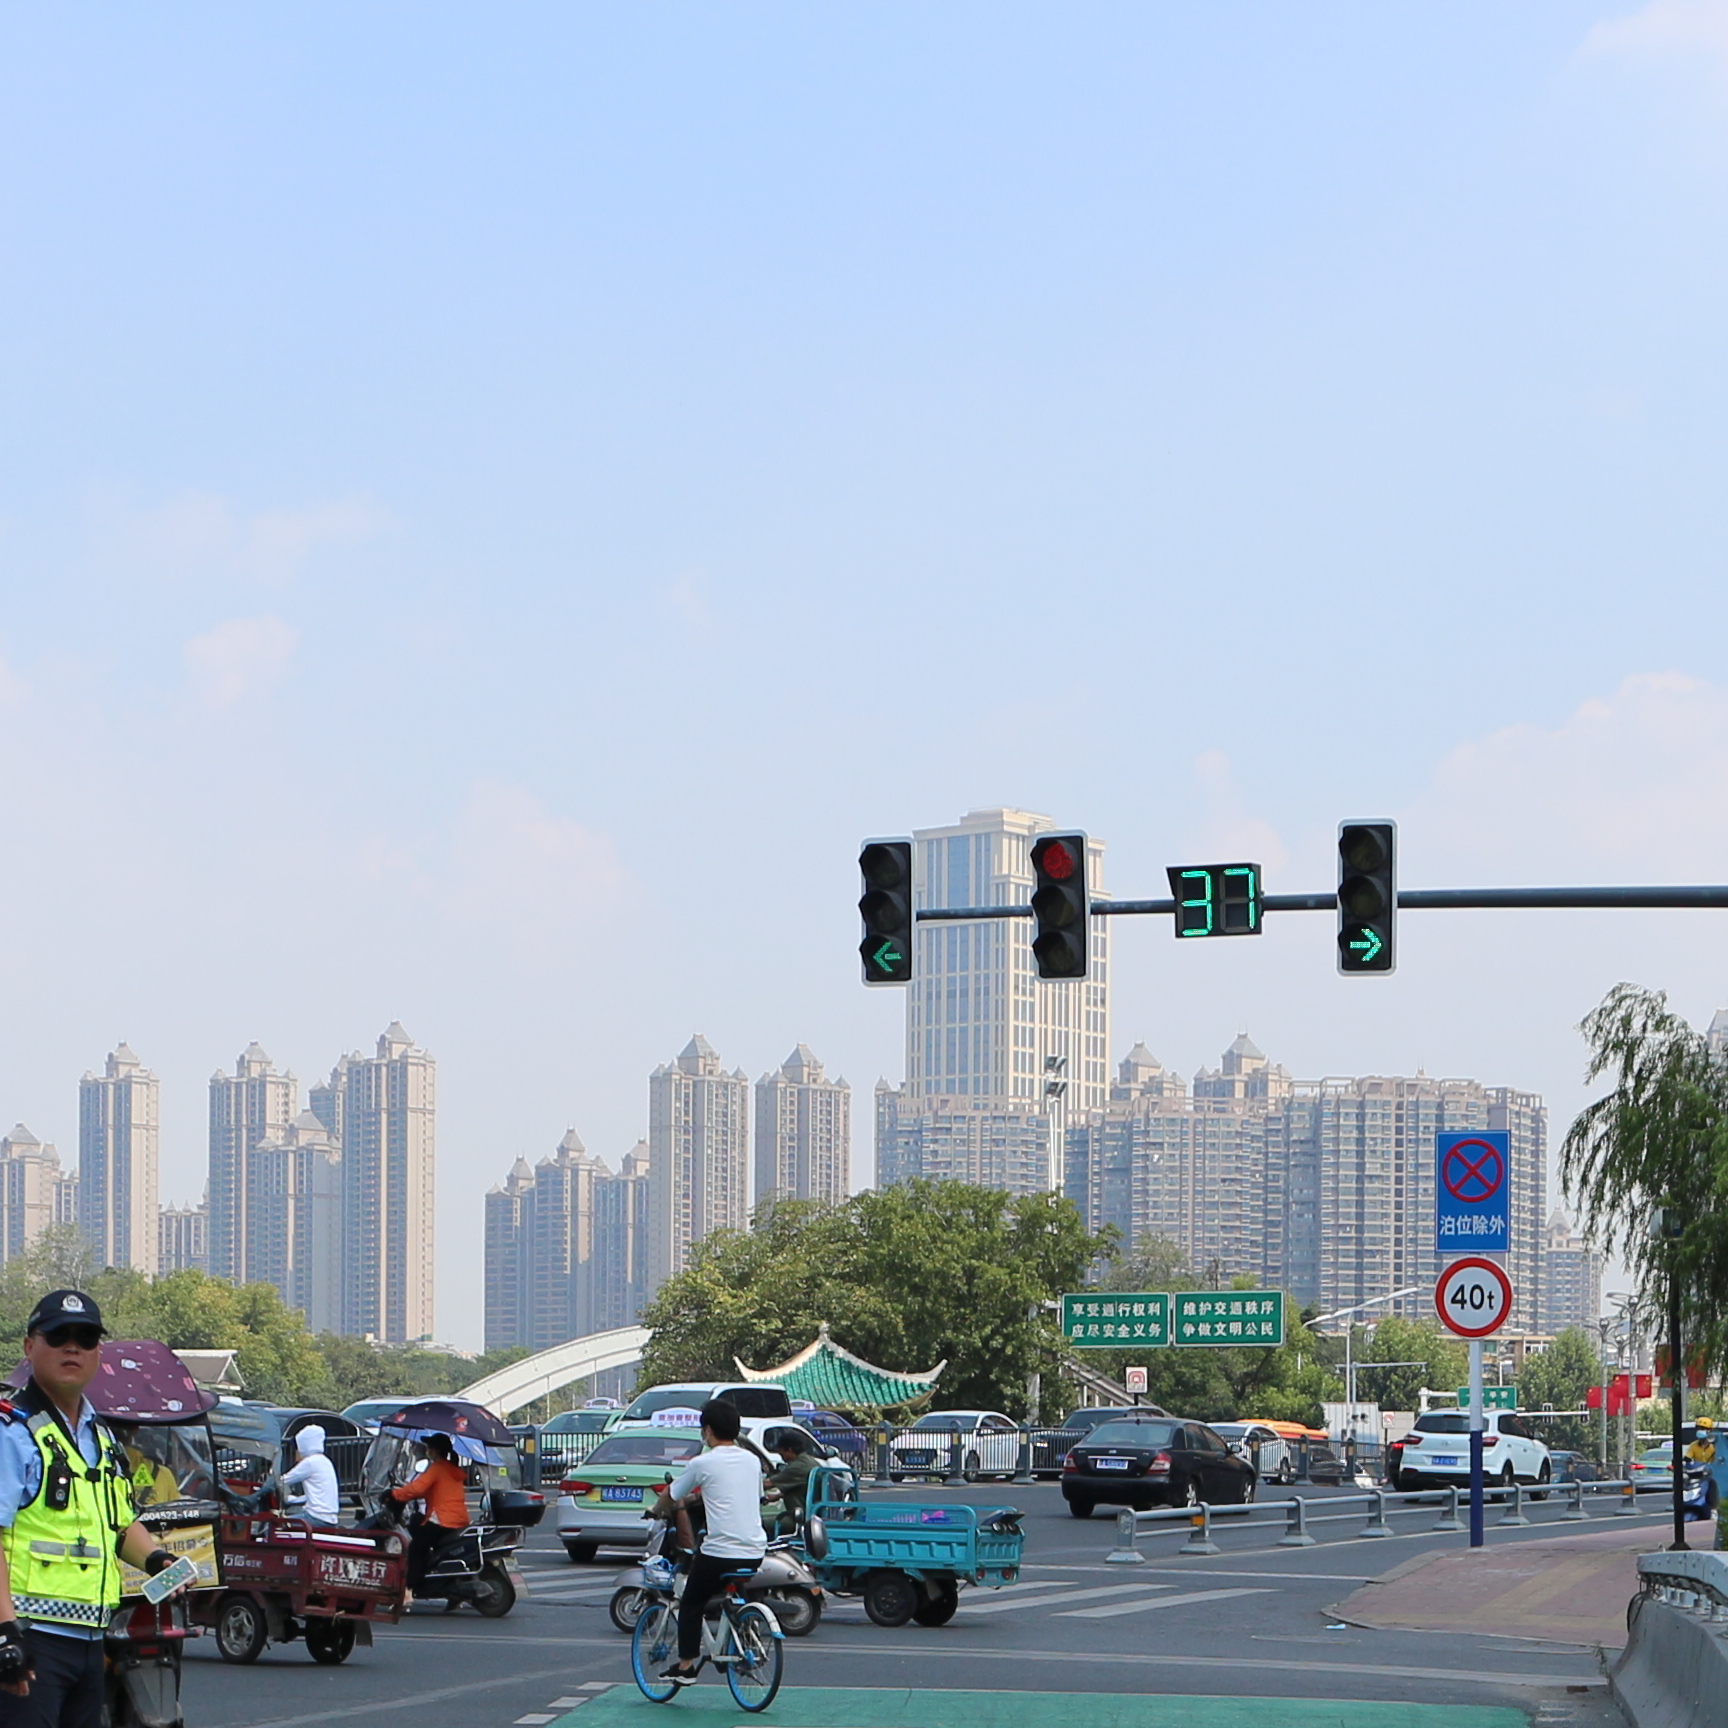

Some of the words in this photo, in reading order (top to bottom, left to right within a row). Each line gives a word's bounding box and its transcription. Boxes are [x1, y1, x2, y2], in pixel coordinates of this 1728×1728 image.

[1180, 868, 1256, 936] 37
[1439, 1215, 1506, 1236] 泊位除外
[1450, 1283, 1495, 1310] 40t
[1071, 1302, 1162, 1317] 享受通行权利
[1182, 1300, 1275, 1316] 维护交通秩序
[1071, 1323, 1162, 1338] 应尽安全义务
[1182, 1321, 1274, 1337] 争做文明公民
